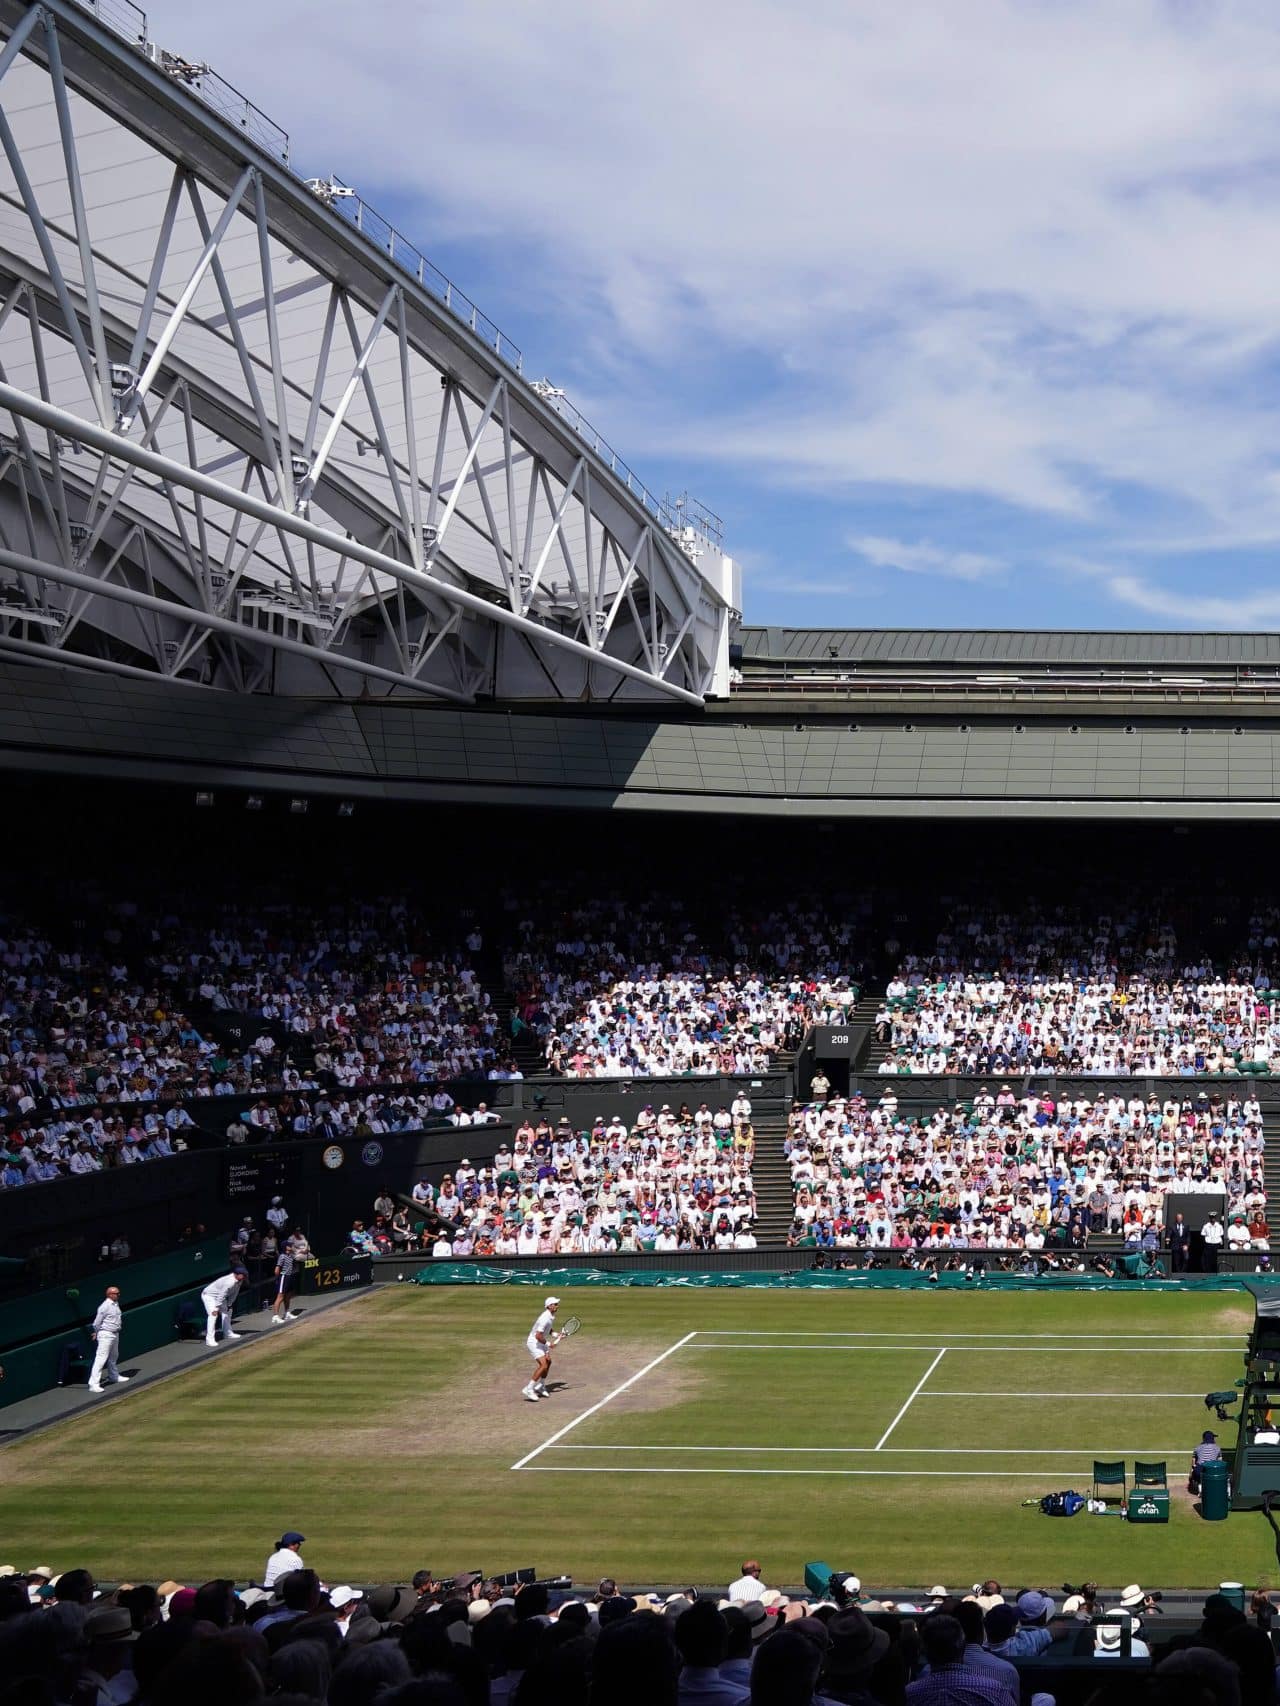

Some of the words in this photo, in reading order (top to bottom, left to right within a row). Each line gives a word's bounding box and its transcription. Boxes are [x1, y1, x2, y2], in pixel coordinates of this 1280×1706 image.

[831, 1035, 849, 1044] 209
[314, 1269, 341, 1287] 123
[343, 1273, 360, 1283] mph
[1137, 1507, 1160, 1515] evian
